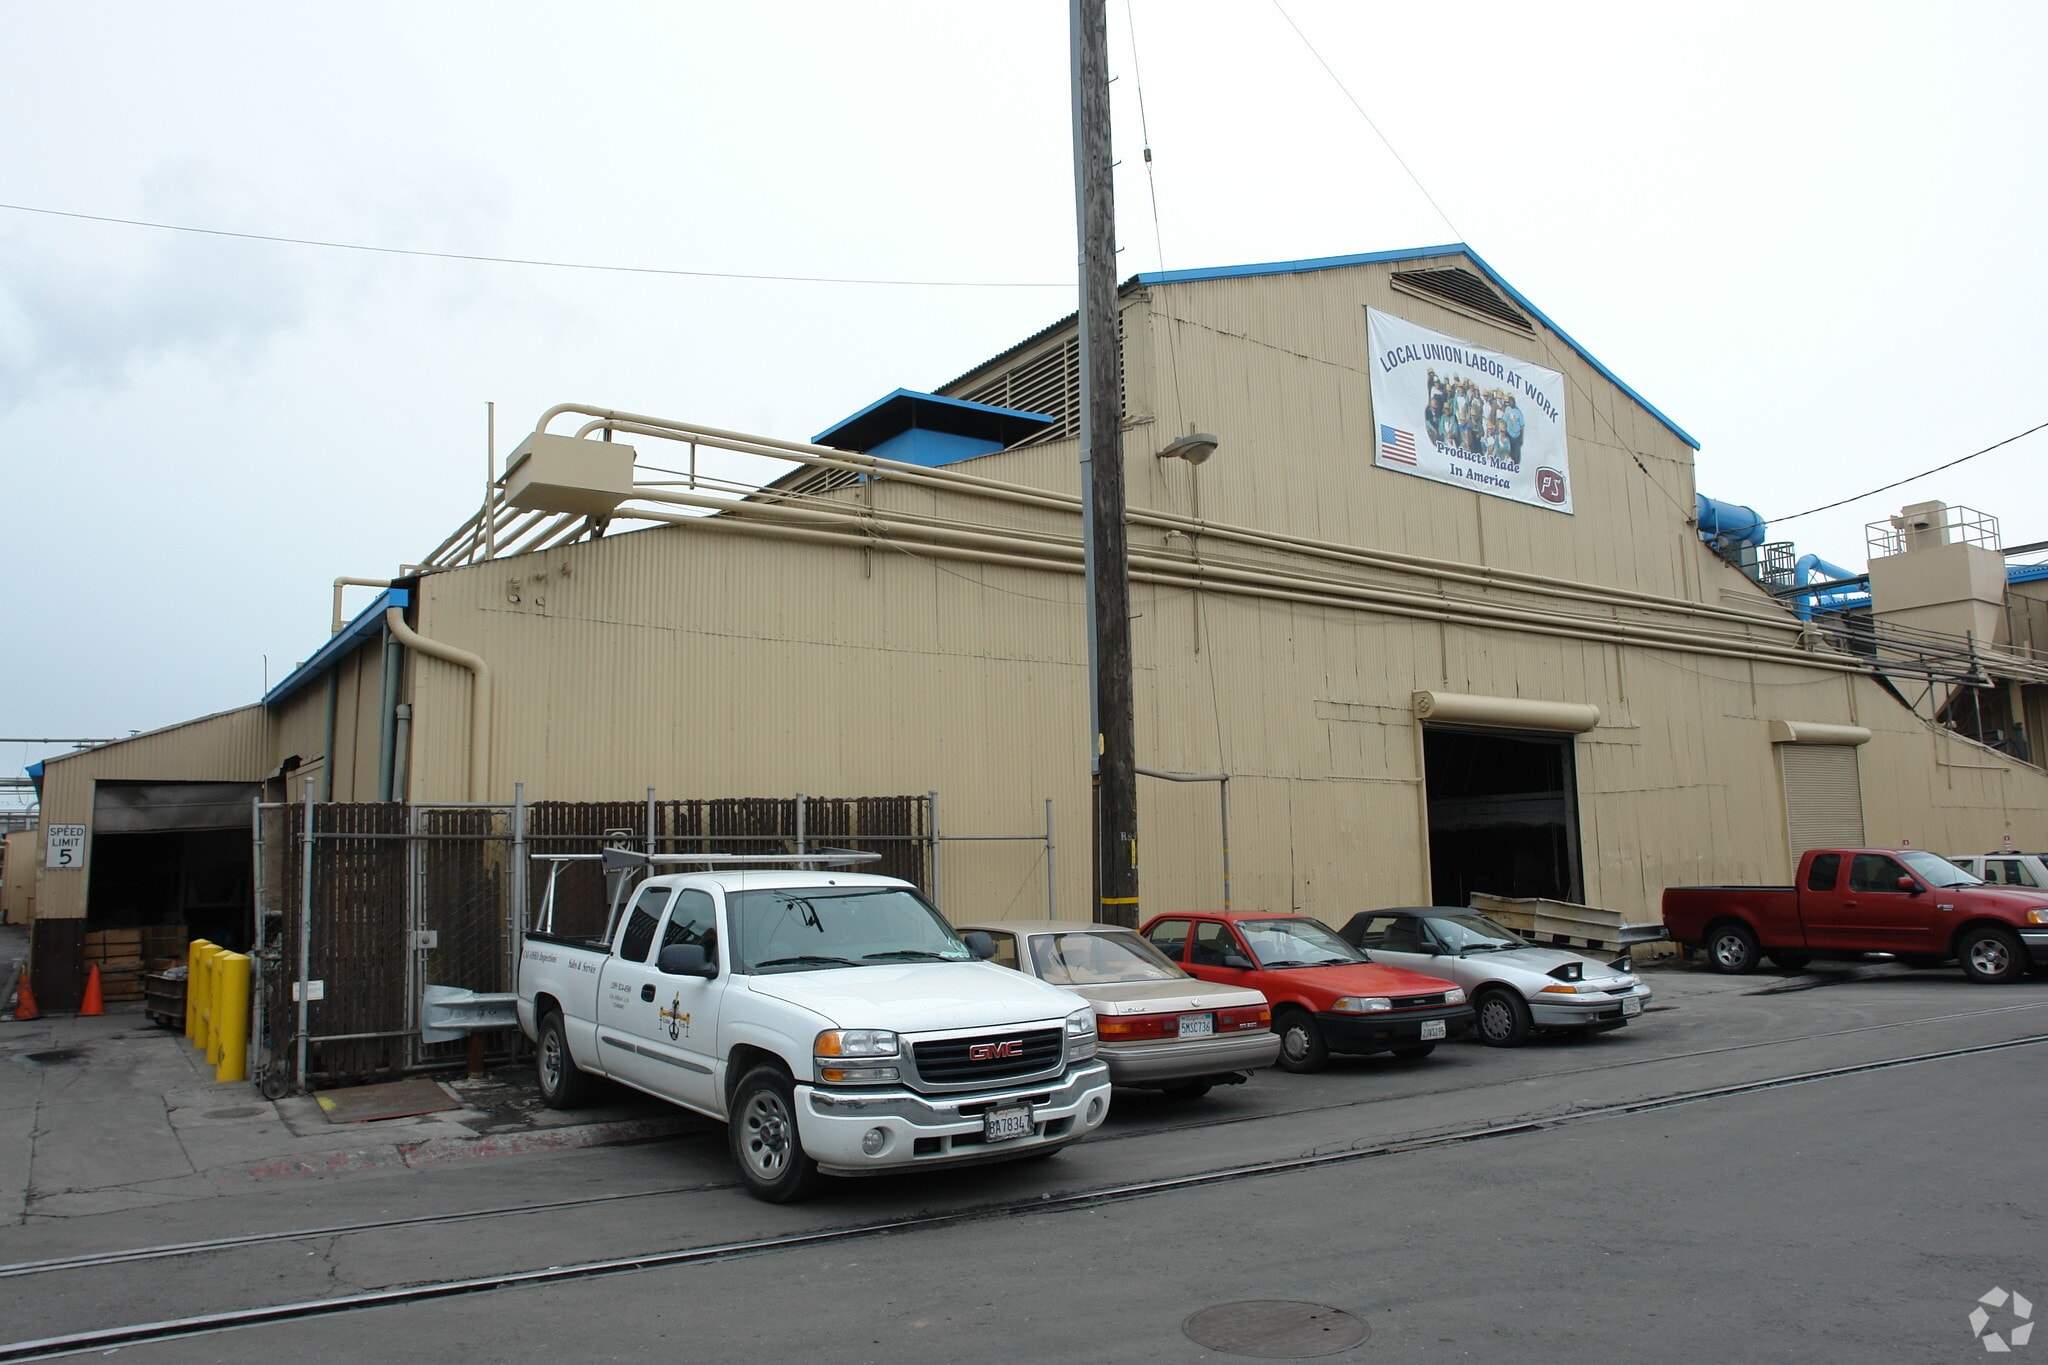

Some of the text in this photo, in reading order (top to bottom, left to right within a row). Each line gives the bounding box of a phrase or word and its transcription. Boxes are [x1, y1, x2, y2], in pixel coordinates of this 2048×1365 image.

[1380, 343, 1560, 423] LOCAL UNION LABOR AT WORK
[1436, 441, 1520, 474] Products Made
[1449, 463, 1511, 490] In America
[50, 827, 84, 836] SPEED
[52, 838, 81, 847] LIMIT
[59, 849, 72, 865] 5
[567, 958, 597, 974] Sales & Service
[1181, 1021, 1211, 1034] 5MSC736
[969, 1039, 1023, 1061] GMC
[989, 1114, 1030, 1135] 8A78347
